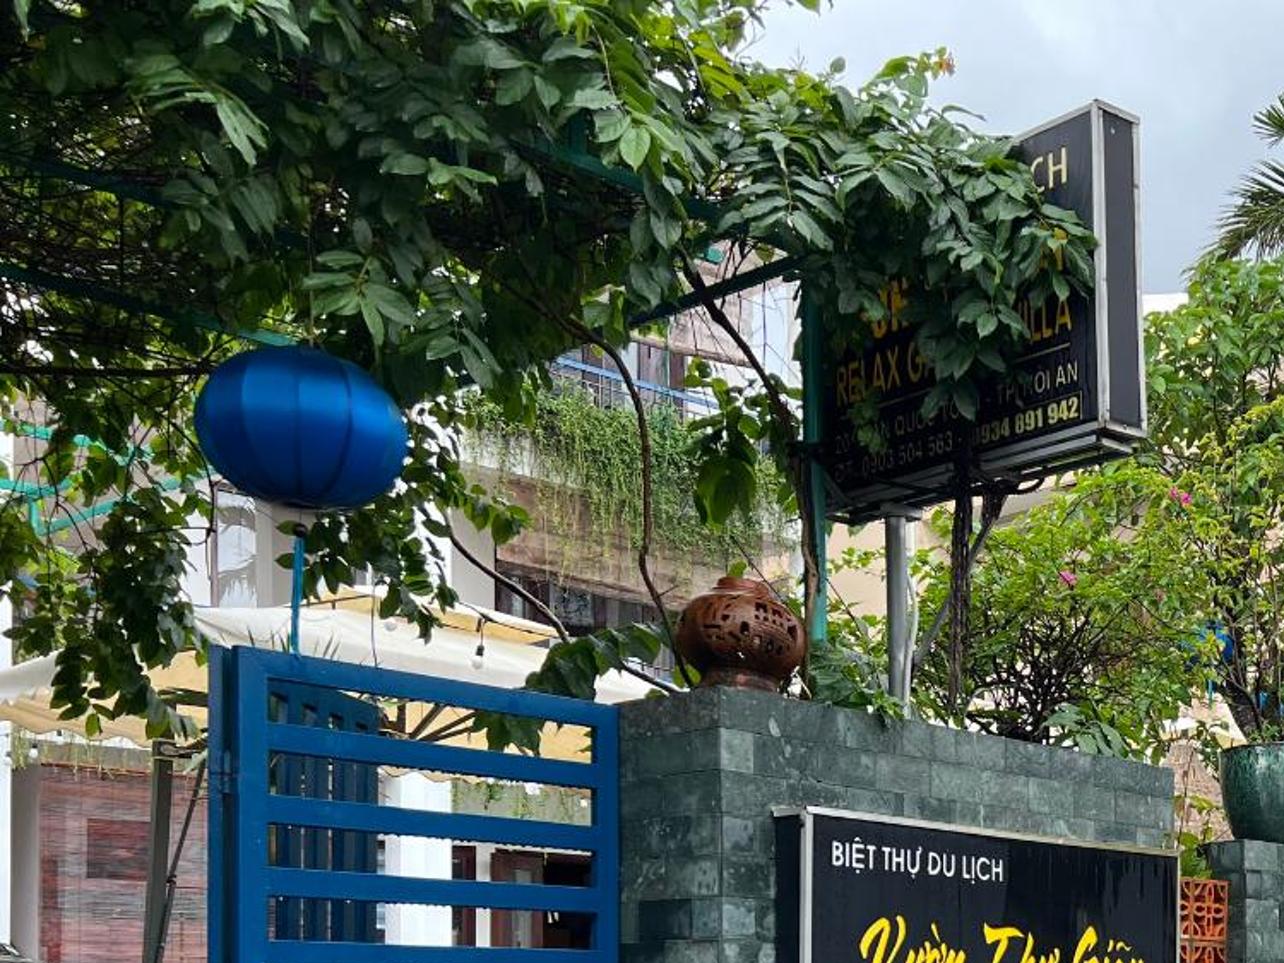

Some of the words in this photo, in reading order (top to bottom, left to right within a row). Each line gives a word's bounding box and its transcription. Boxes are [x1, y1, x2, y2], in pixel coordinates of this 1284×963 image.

[835, 346, 900, 408] RELAX
[1055, 359, 1078, 388] AN
[1014, 407, 1043, 434] 891
[1047, 396, 1079, 425] 942
[831, 837, 876, 874] BIỆT
[881, 845, 922, 879] THỰ
[927, 851, 956, 878] DU
[962, 855, 1003, 884] LỊCH
